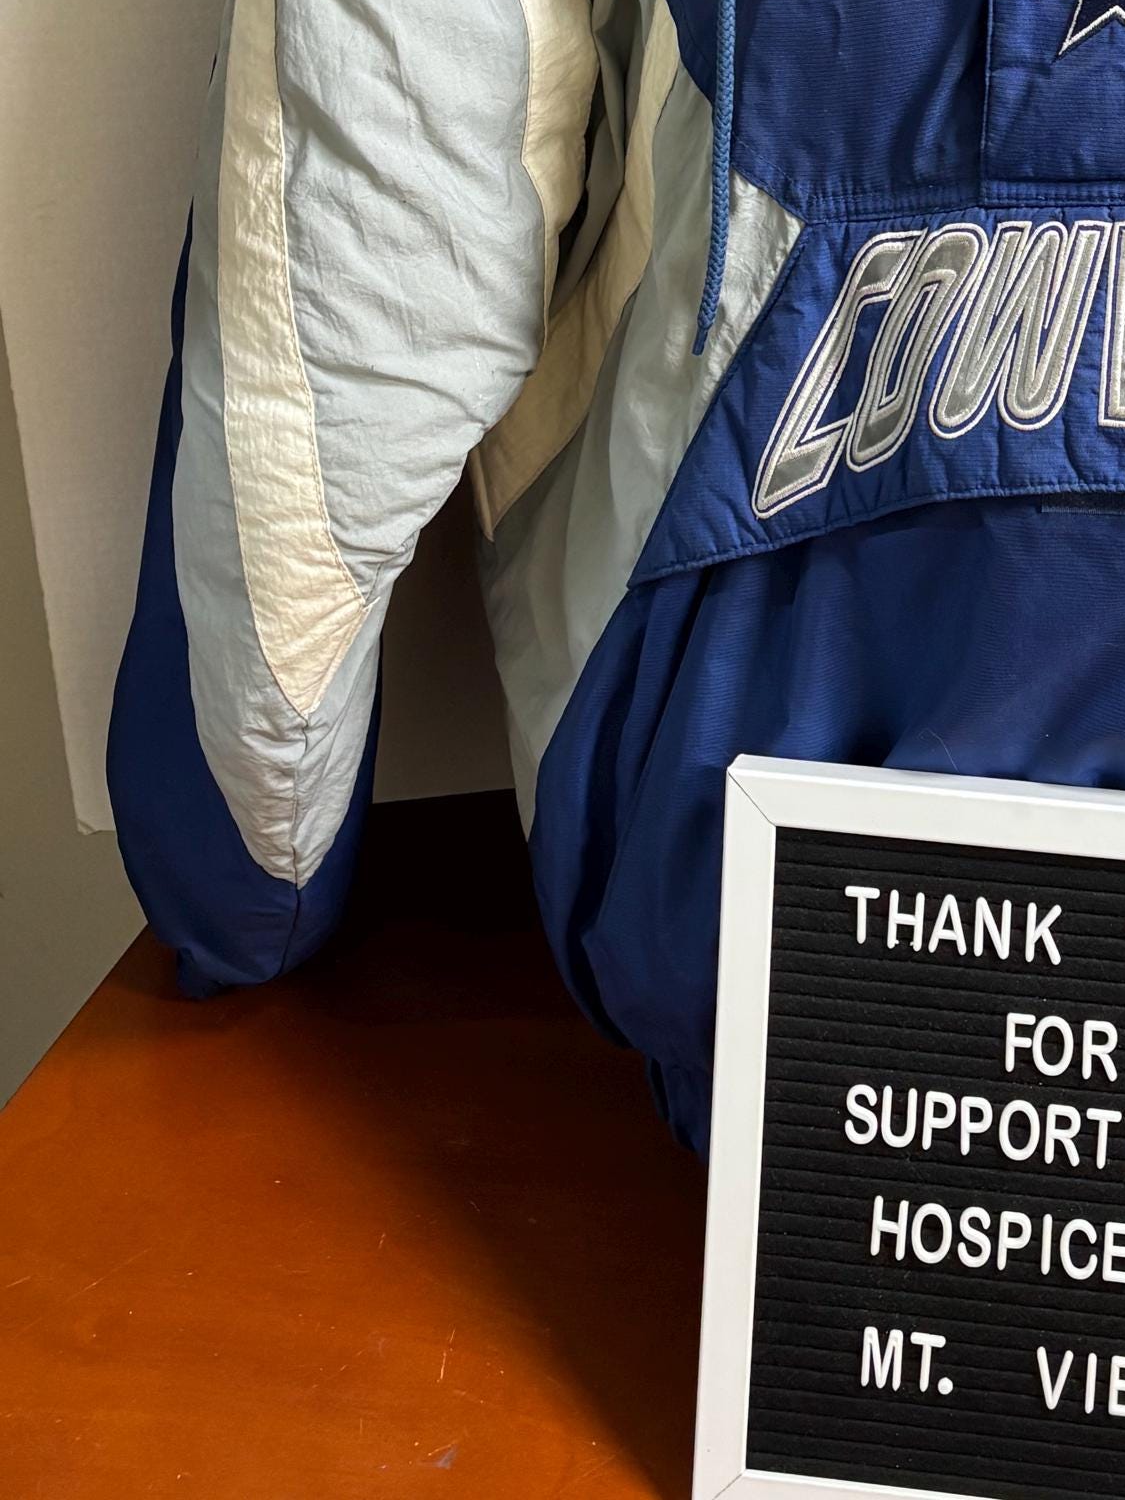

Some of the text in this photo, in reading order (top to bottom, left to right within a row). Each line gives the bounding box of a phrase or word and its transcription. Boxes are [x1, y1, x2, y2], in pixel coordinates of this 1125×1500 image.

[844, 885, 1062, 966] THANK
[1005, 1012, 1118, 1082] FOR
[860, 1325, 954, 1395] MT.
